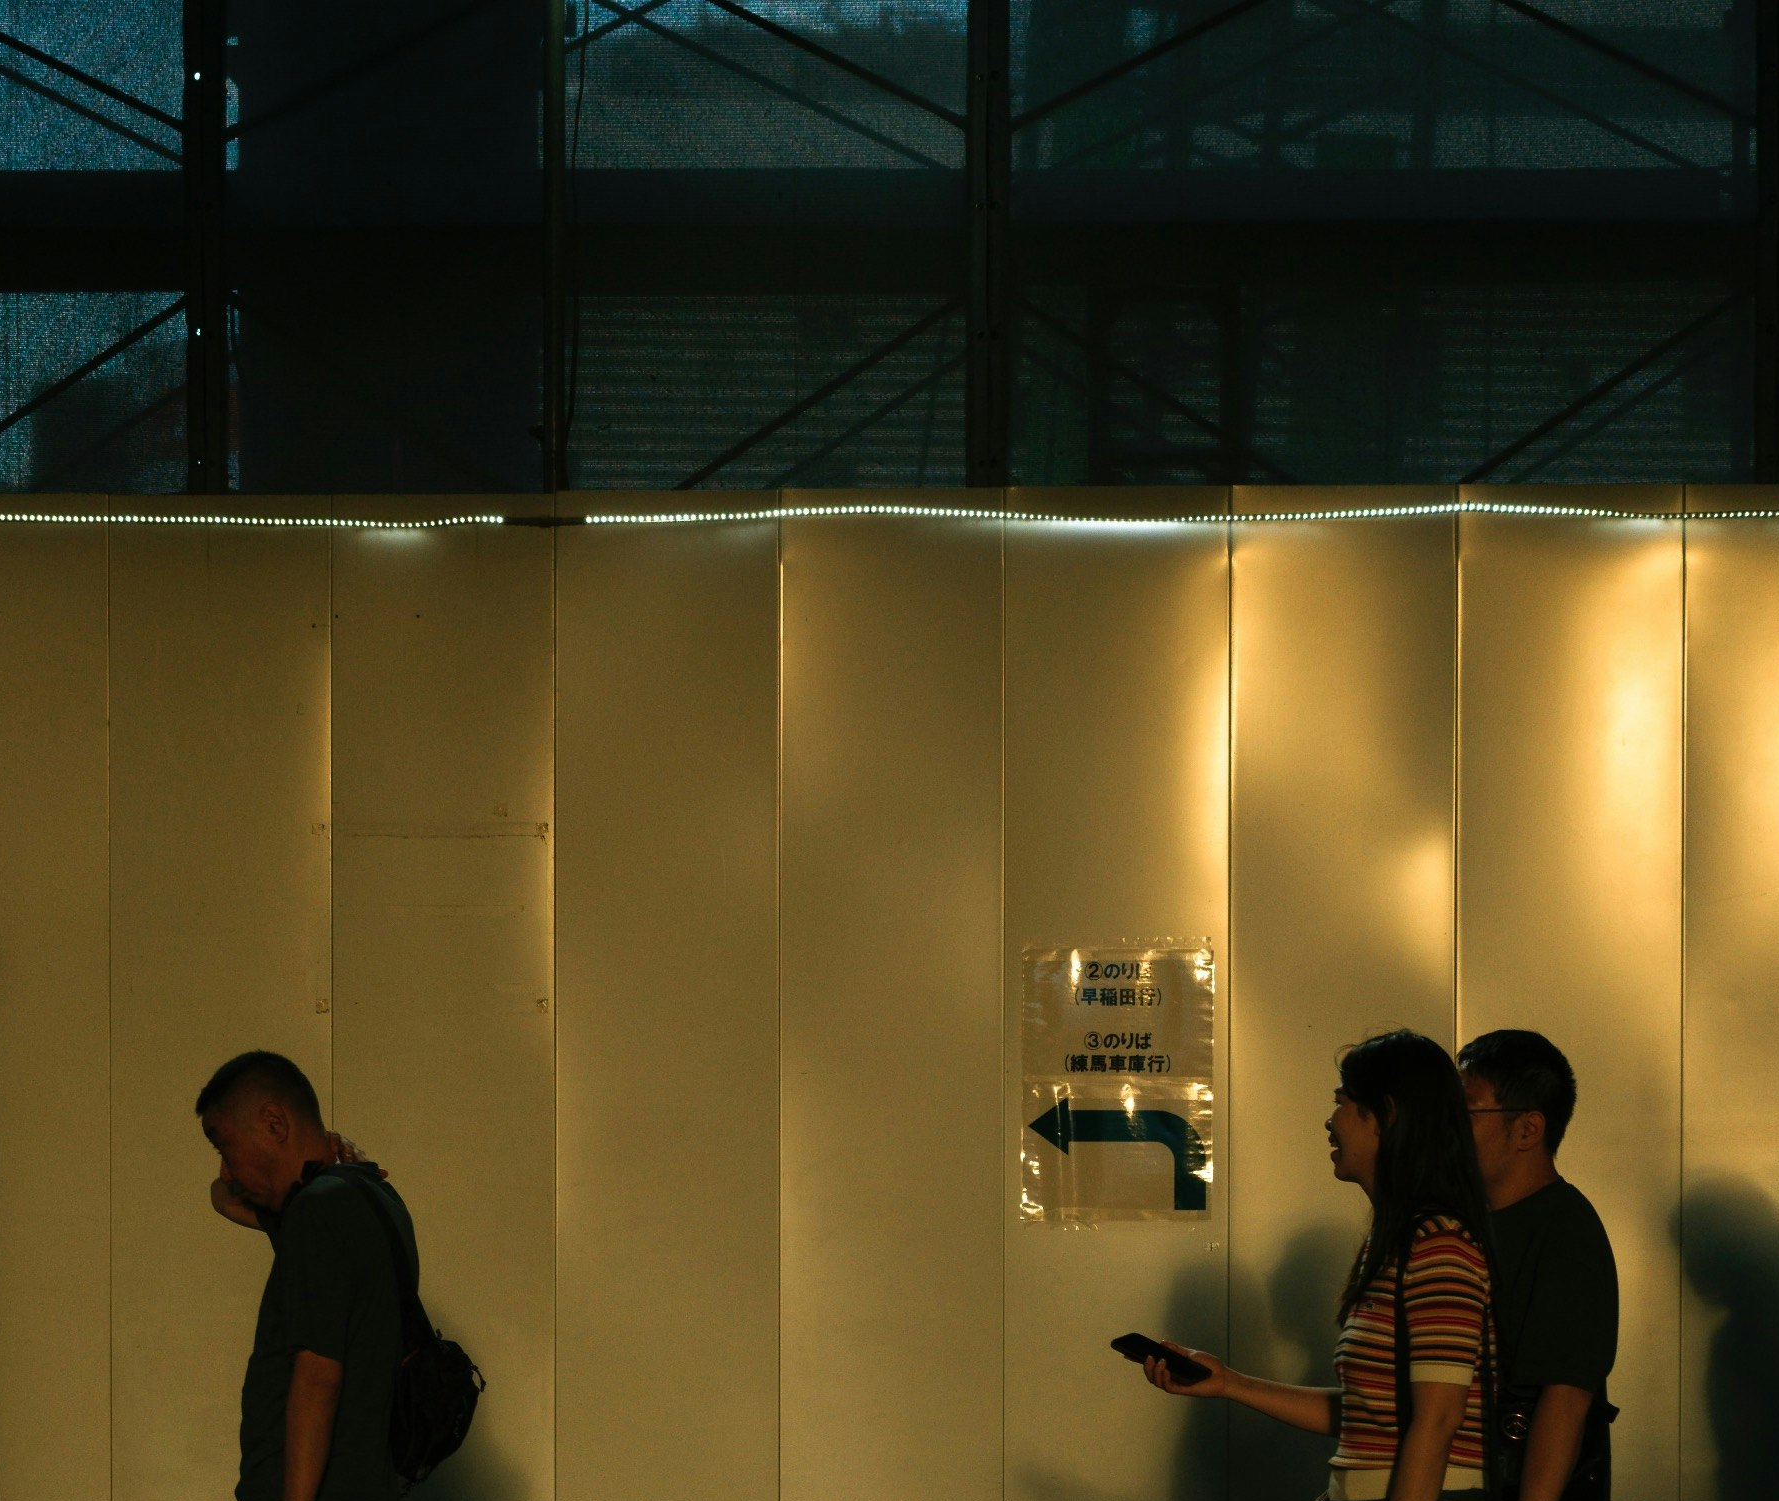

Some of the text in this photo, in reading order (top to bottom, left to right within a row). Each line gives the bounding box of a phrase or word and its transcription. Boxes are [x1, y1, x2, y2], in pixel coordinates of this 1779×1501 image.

[1074, 988, 1162, 1006] (早稲田行)
[1083, 1032, 1152, 1050] ③のりば
[1064, 1054, 1171, 1073] (練馬車庫行)
